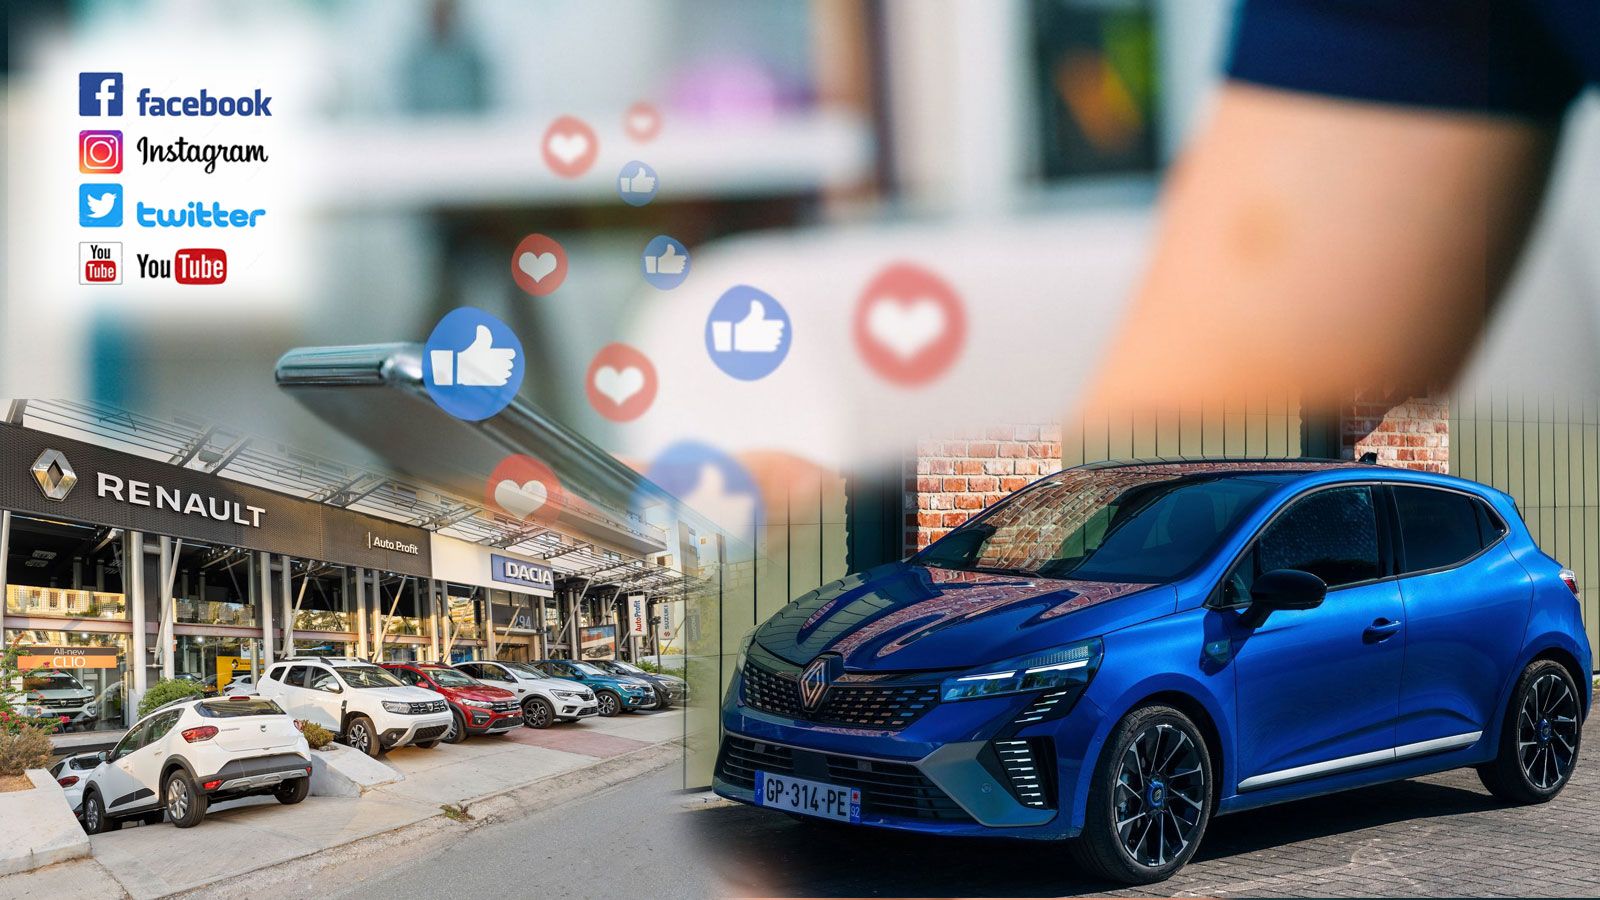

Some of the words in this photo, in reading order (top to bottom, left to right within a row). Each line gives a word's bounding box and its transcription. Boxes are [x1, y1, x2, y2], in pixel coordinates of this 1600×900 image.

[97, 472, 266, 528] RENAULT
[373, 536, 394, 549] Auto
[396, 541, 418, 555] Profit
[506, 561, 553, 585] DACIA
[53, 647, 85, 656] All-new
[53, 656, 86, 668] CLIO
[766, 778, 847, 817] GP-314-PE
[850, 806, 860, 818] 92
